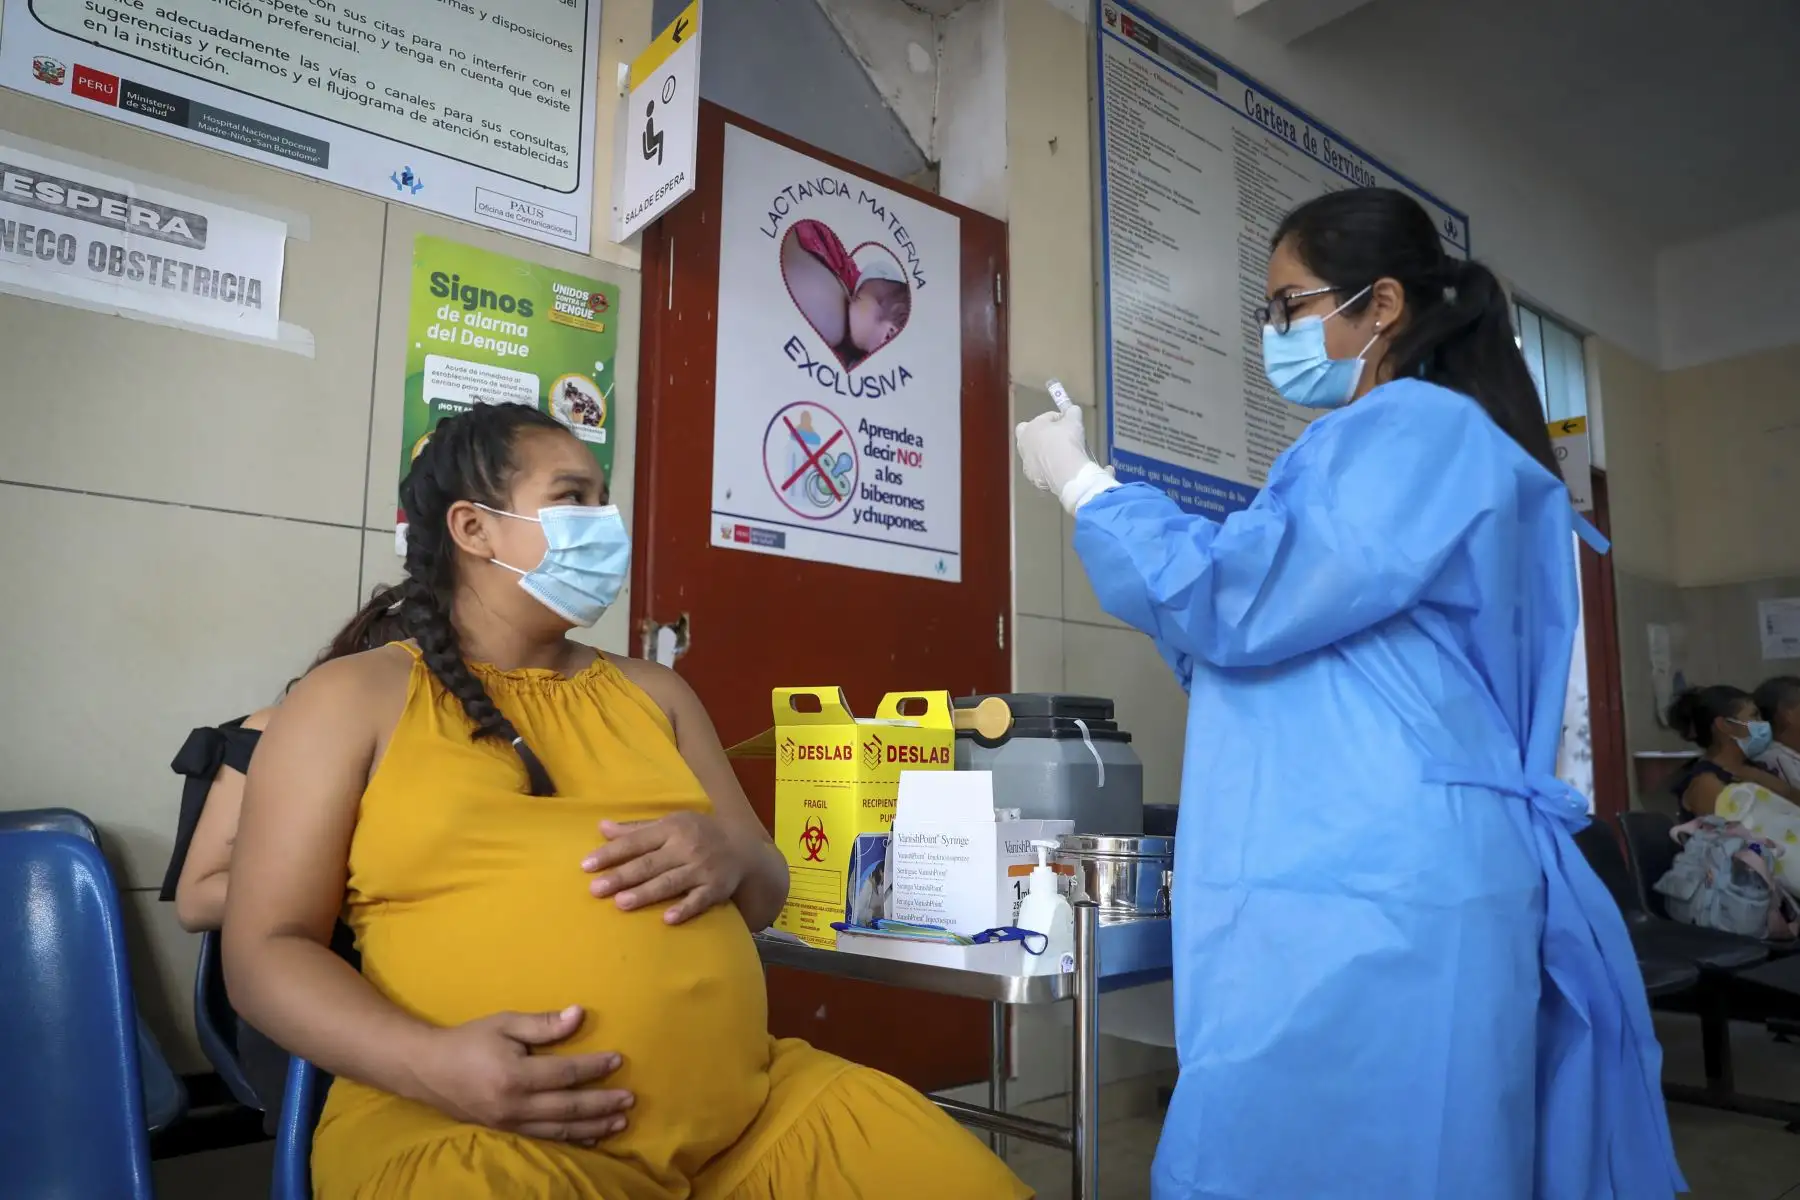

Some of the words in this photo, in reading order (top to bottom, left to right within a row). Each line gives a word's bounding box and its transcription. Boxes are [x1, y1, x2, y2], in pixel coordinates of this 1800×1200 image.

[267, 13, 360, 53] preferencial.
[437, 0, 474, 14] mas
[480, 10, 487, 21] y
[491, 14, 573, 53] disposiciones
[84, 19, 107, 34] en
[114, 25, 129, 41] la
[136, 33, 229, 75] institución.
[308, 0, 336, 12] con
[343, 8, 367, 24] sus
[374, 20, 405, 38] citas
[412, 34, 442, 51] para
[449, 47, 466, 60] no
[473, 54, 527, 82] interferir
[532, 78, 555, 93] con
[560, 88, 571, 98] el
[315, 14, 331, 26] su
[337, 20, 376, 43] turno
[381, 38, 390, 49] y
[395, 41, 434, 63] tenga
[439, 59, 456, 72] en
[460, 66, 504, 89] cuenta
[508, 83, 532, 98] que
[536, 93, 570, 112] existe
[78, 76, 113, 94] PERÚ
[85, 0, 192, 45] sugerencias
[199, 40, 208, 52] y
[215, 45, 287, 77] reclamos
[292, 71, 302, 84] y
[308, 77, 321, 89] el
[327, 80, 404, 116] flujograma
[410, 110, 427, 123] de
[432, 117, 489, 144] atención
[493, 138, 569, 169] establecidas
[155, 7, 290, 61] adecuadamente
[300, 54, 320, 72] las
[329, 67, 357, 84] vías
[366, 81, 376, 90] o
[384, 87, 435, 111] canales
[444, 106, 473, 123] para
[481, 119, 502, 133] sus
[509, 128, 569, 156] consultas,
[126, 100, 139, 109] de
[141, 104, 167, 117] Salud
[127, 91, 176, 112] Ministerio
[203, 113, 240, 131] Hospital
[242, 124, 280, 143] Nacional
[281, 137, 317, 153] Docente
[1244, 88, 1296, 142] Cartera
[1303, 125, 1317, 154] de
[1323, 137, 1376, 188] Servicios
[2, 171, 193, 240] ESPERA
[510, 201, 544, 219] PAUS
[625, 203, 643, 224] SALA
[644, 194, 654, 210] DE
[655, 171, 685, 201] ESPERA
[478, 203, 504, 216] Oficina
[505, 211, 515, 220] de
[515, 214, 573, 236] Comunicaciones
[760, 176, 851, 239] LACTANCIA
[858, 190, 926, 290] MATERNA
[87, 241, 262, 309] OBSTETRICIA
[553, 282, 589, 301] UNIDOS
[430, 271, 534, 317] Signos
[555, 301, 595, 320] DENGUE
[556, 295, 580, 306] CONTRA
[436, 304, 460, 323] de
[464, 309, 528, 338] alarma
[426, 323, 456, 344] del
[461, 332, 529, 357] Dengue
[784, 336, 913, 399] EXCLUSIVA
[858, 418, 915, 447] Aprende
[915, 437, 924, 448] a
[863, 442, 895, 463] decir
[896, 448, 922, 468] NO!
[875, 469, 883, 481] a
[884, 468, 903, 485] los
[861, 483, 925, 511] biberones
[853, 509, 862, 524] y
[863, 506, 927, 532] chupones.
[798, 745, 852, 760] DESLAB
[887, 745, 950, 764] DESLAB
[804, 799, 827, 809] FRAGIL
[941, 834, 969, 848] Syringe
